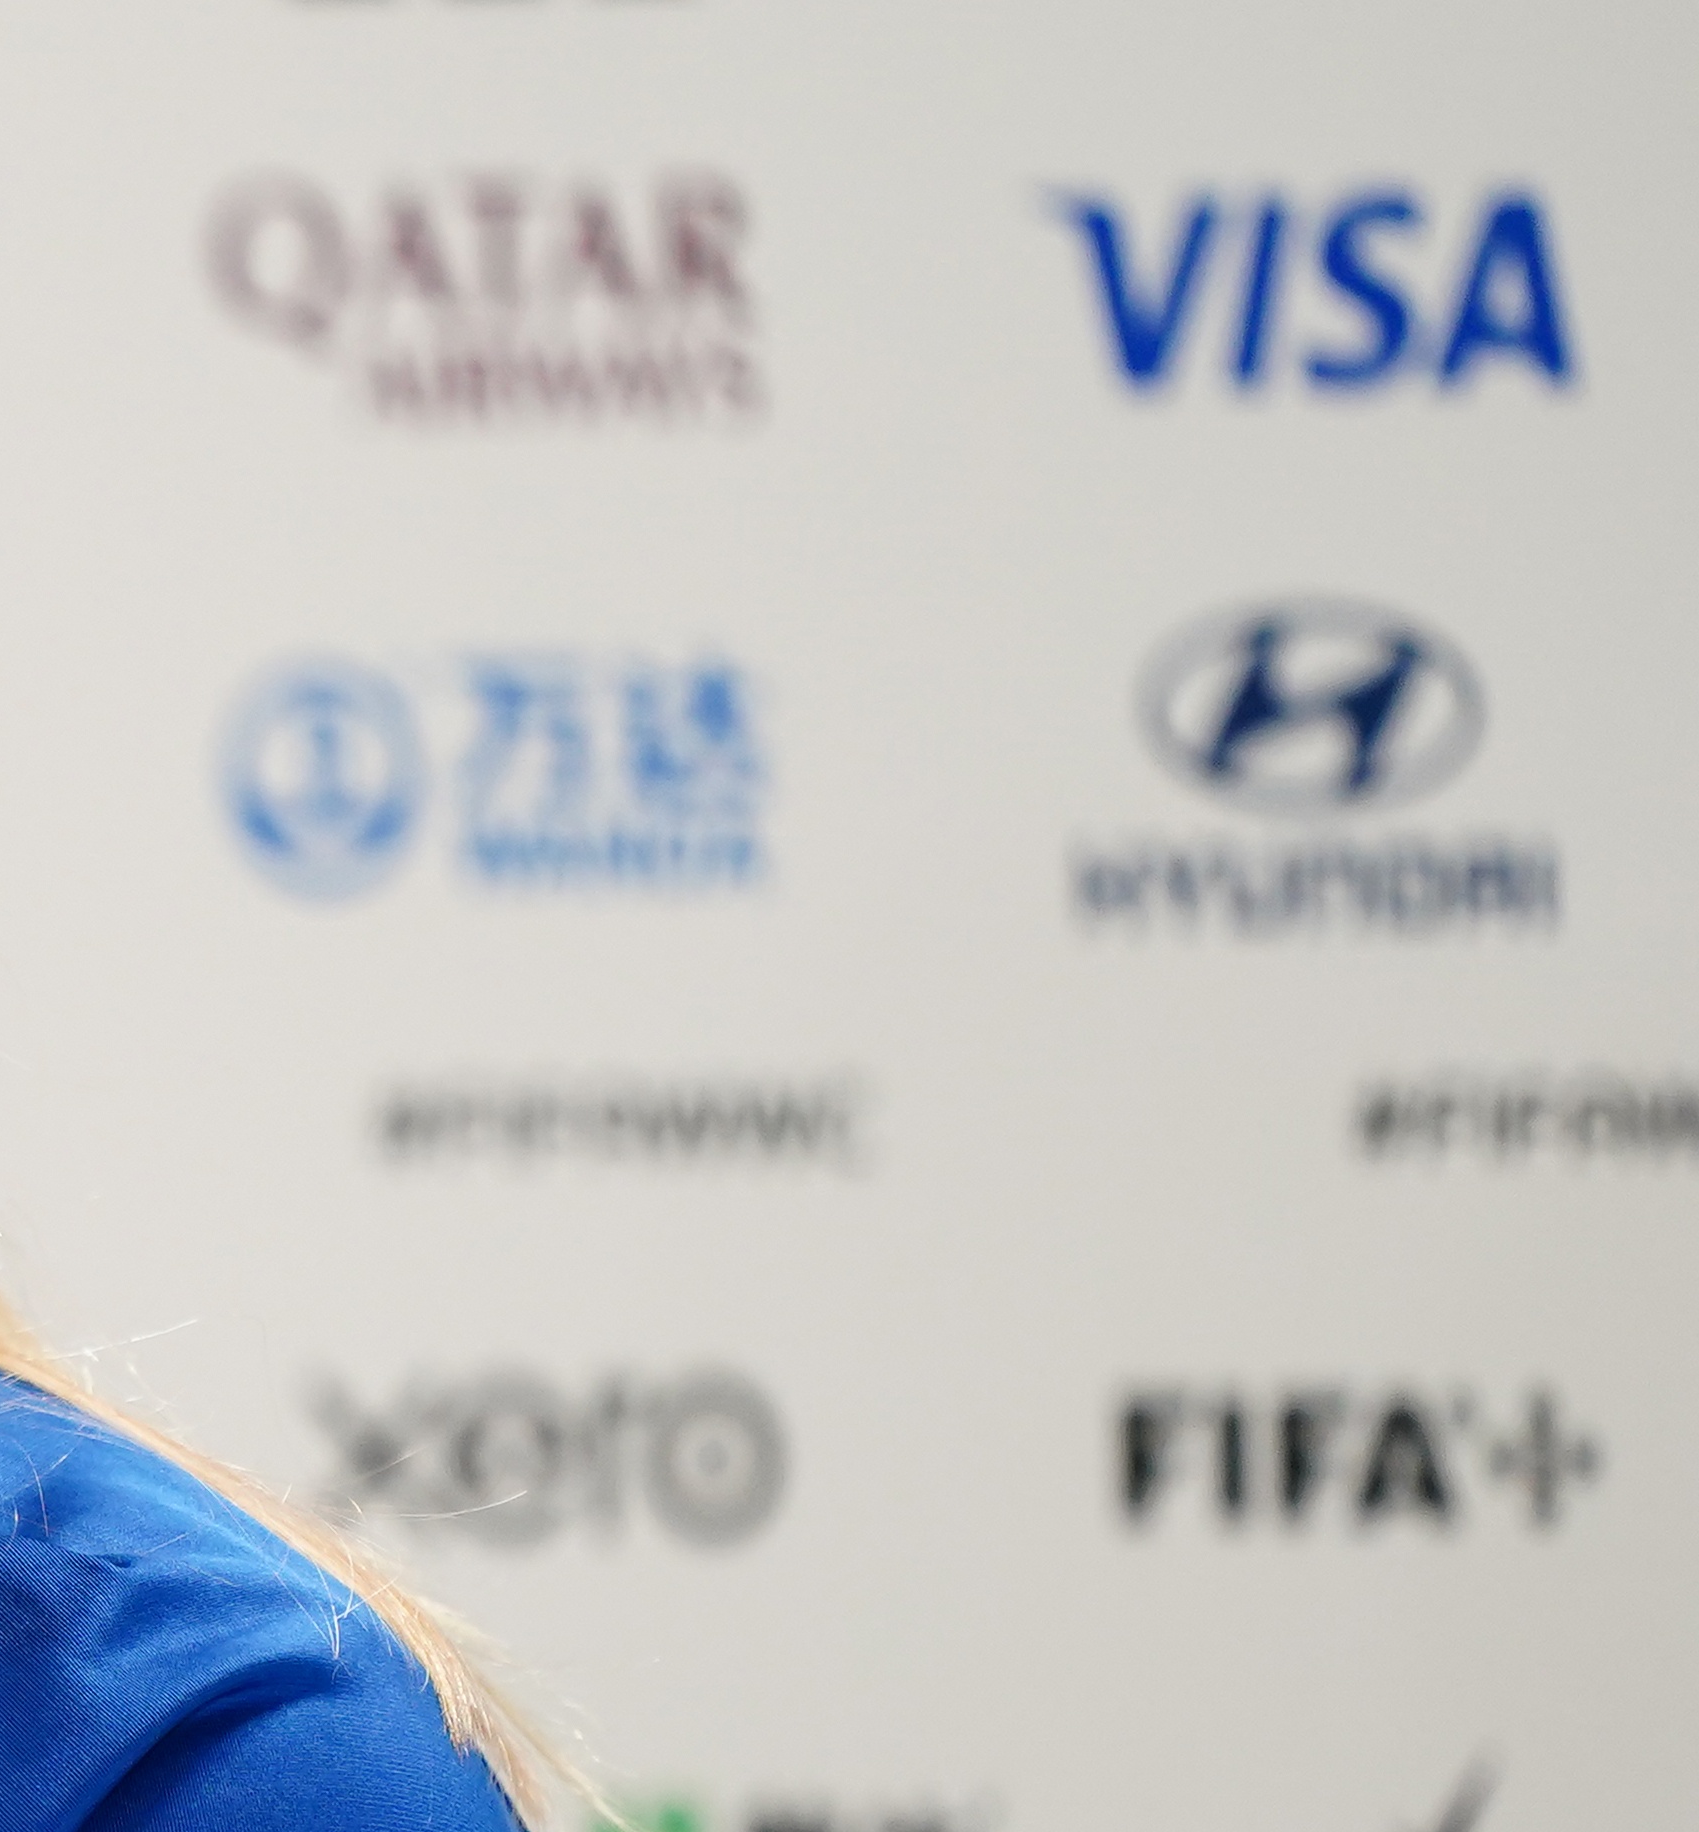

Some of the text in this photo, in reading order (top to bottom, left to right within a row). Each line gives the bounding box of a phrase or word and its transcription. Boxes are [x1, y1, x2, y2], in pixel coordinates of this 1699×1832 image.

[210, 172, 752, 358] QATAR
[1052, 182, 1580, 397] VISA
[1069, 837, 1562, 937] HYUNDAI
